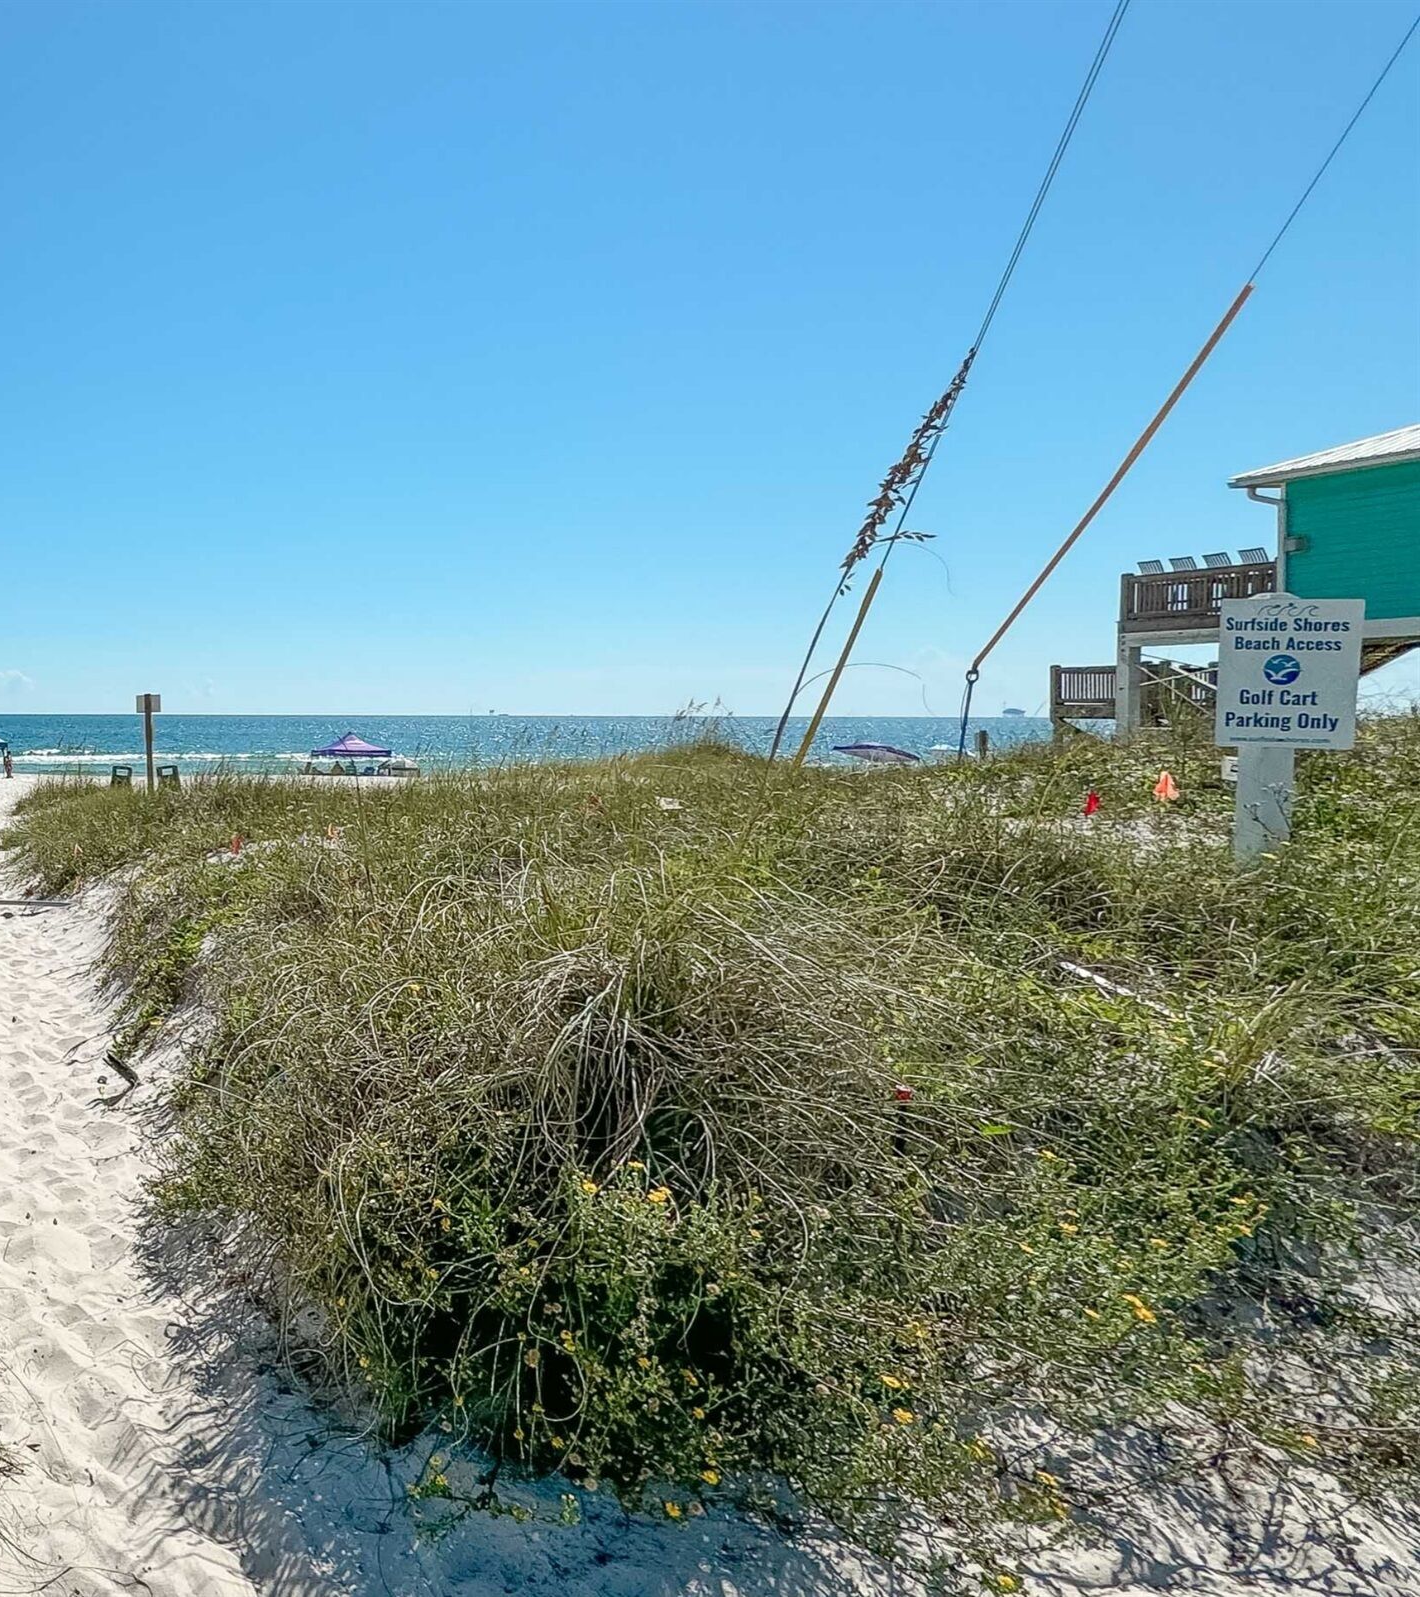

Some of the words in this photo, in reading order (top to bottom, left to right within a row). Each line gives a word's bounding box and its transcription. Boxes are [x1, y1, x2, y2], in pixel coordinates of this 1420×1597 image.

[1225, 617, 1288, 632] Surfside
[1293, 618, 1350, 632] Shores
[1234, 636, 1281, 651] Beach
[1285, 637, 1342, 651] Access
[1239, 689, 1275, 706] Golf
[1279, 689, 1319, 706] Cart
[1225, 711, 1292, 732] Parking
[1297, 713, 1339, 732] Only
